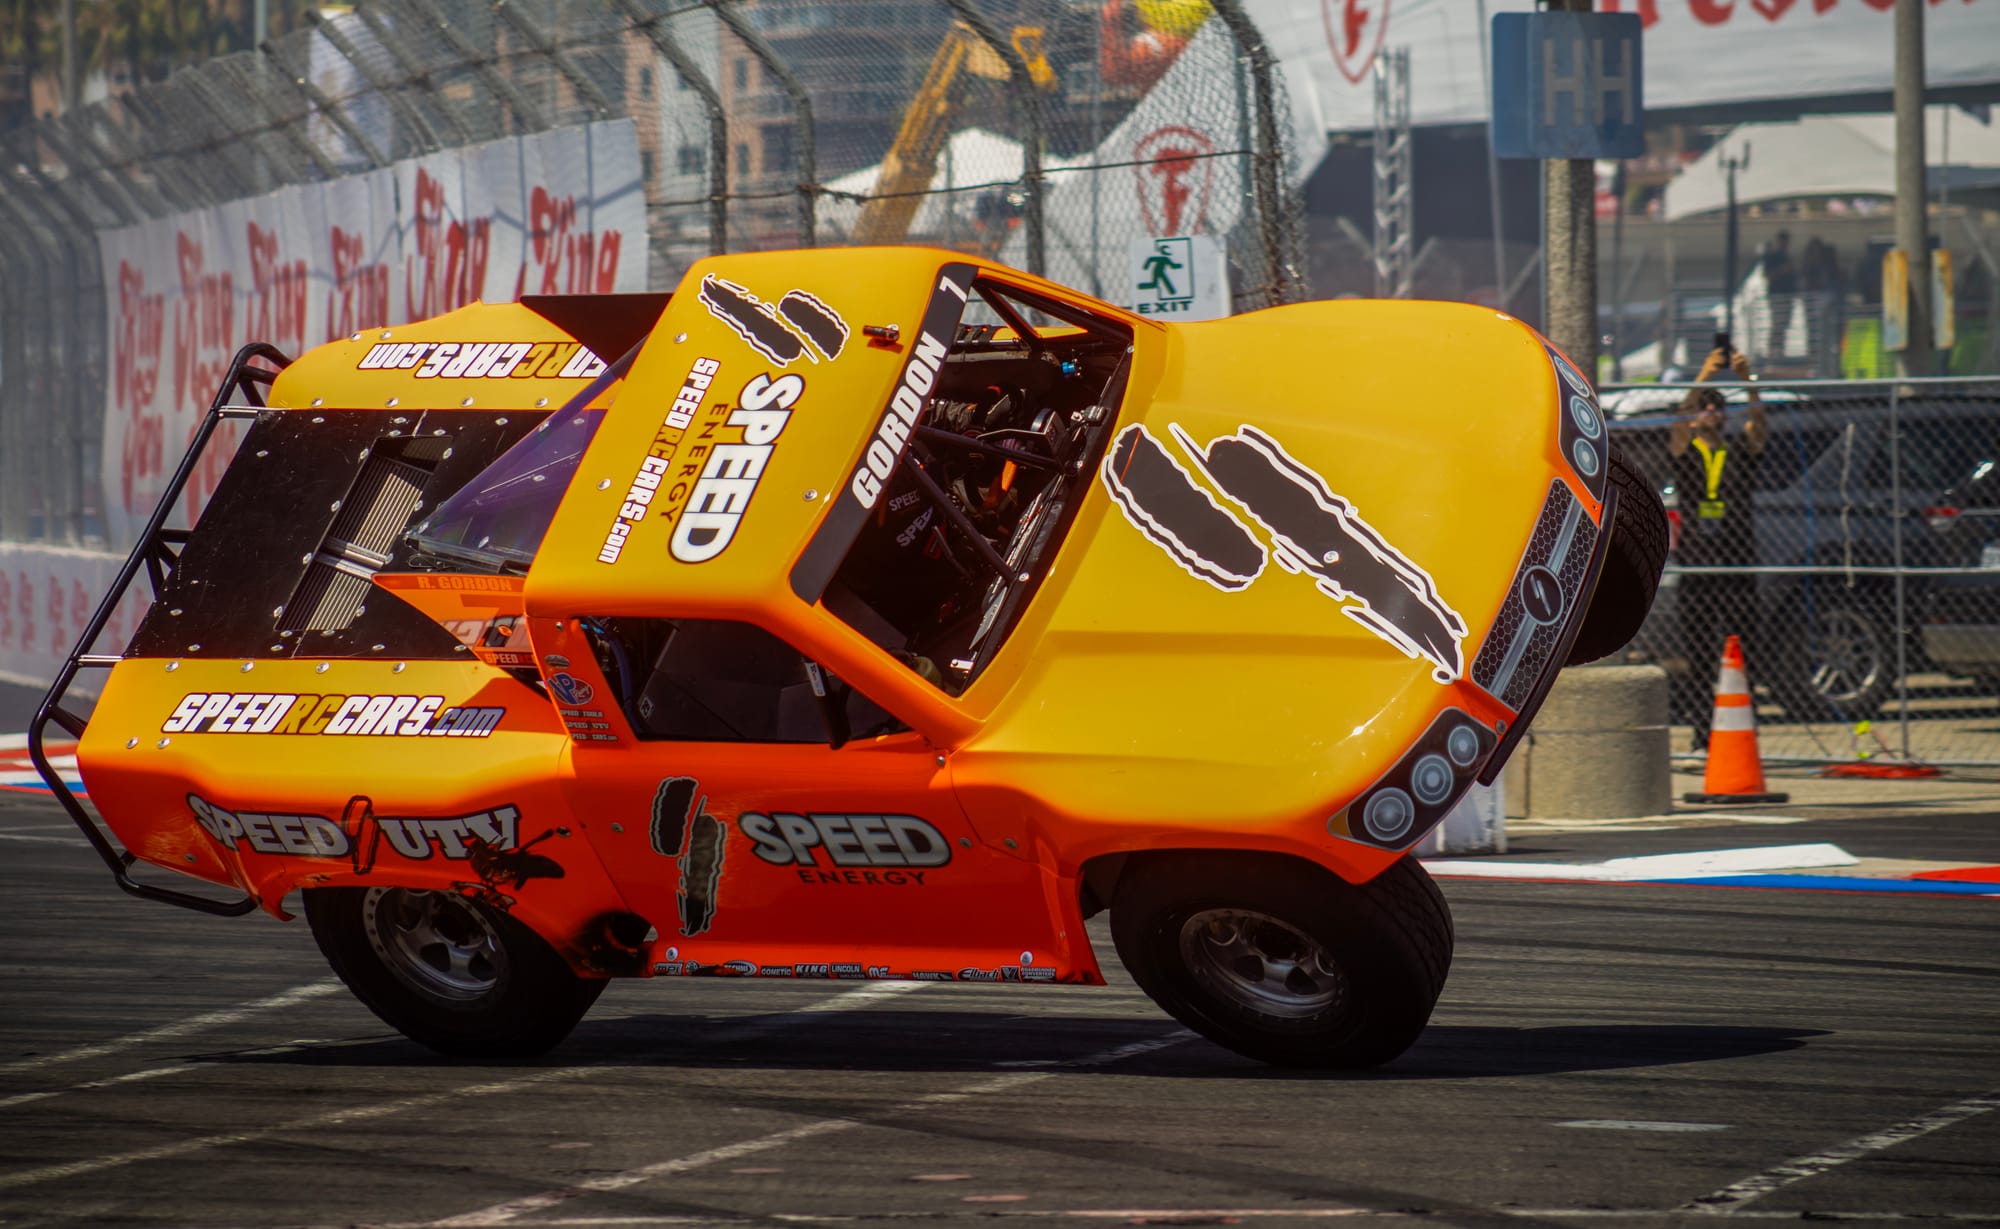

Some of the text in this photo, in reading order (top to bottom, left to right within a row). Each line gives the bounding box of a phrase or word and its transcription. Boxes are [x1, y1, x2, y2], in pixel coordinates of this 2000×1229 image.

[1544, 39, 1633, 126] HH
[1137, 300, 1192, 324] EXIT
[852, 275, 968, 509] GORDON 7
[597, 357, 721, 564] SPEEDRCCARS.com
[660, 403, 729, 523] ENERGY
[668, 371, 806, 565] SPEED
[416, 576, 512, 591] R. GORDON
[161, 692, 507, 737] SPEEDRCCARS.com
[187, 793, 522, 859] SPEED UTV
[738, 812, 953, 868] SPEED
[797, 869, 926, 886] ENERGY
[796, 963, 829, 974] KING
[831, 963, 862, 974] LINCOLN
